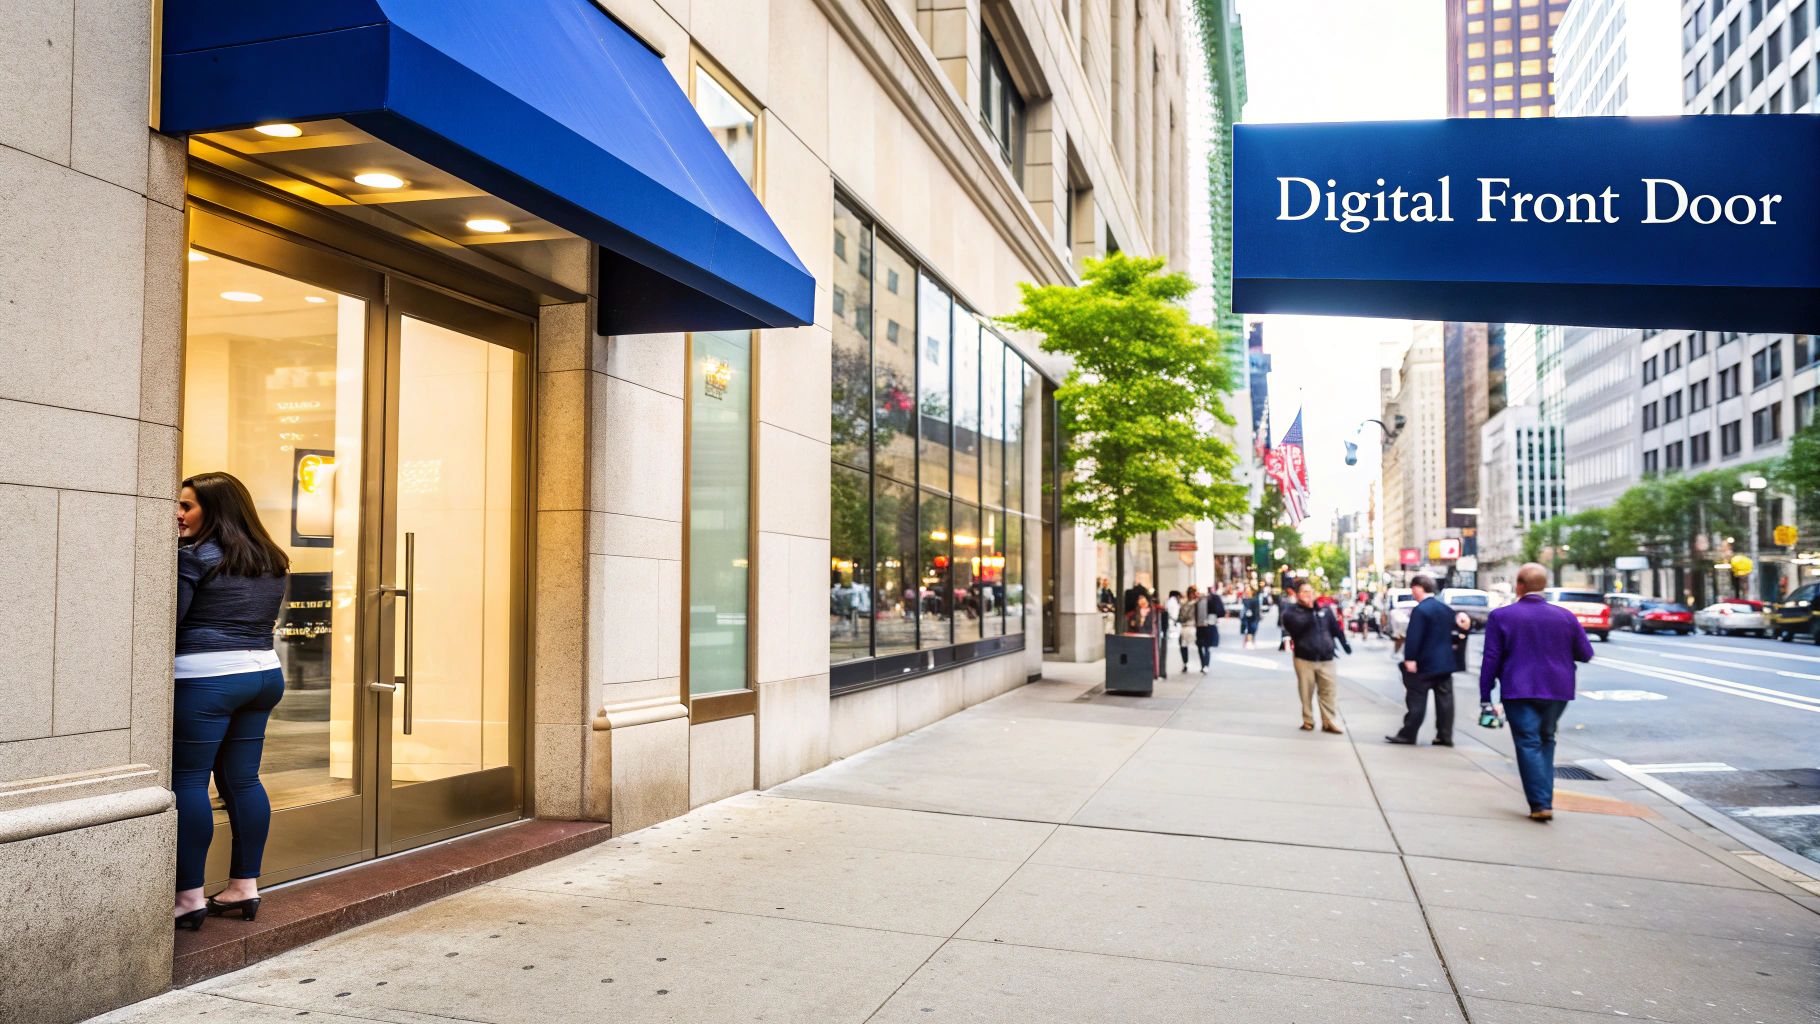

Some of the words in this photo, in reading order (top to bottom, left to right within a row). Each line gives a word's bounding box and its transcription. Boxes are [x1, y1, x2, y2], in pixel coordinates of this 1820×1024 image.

[1276, 175, 1455, 234] Digital
[1476, 177, 1620, 224] Front
[1640, 178, 1783, 225] Door
